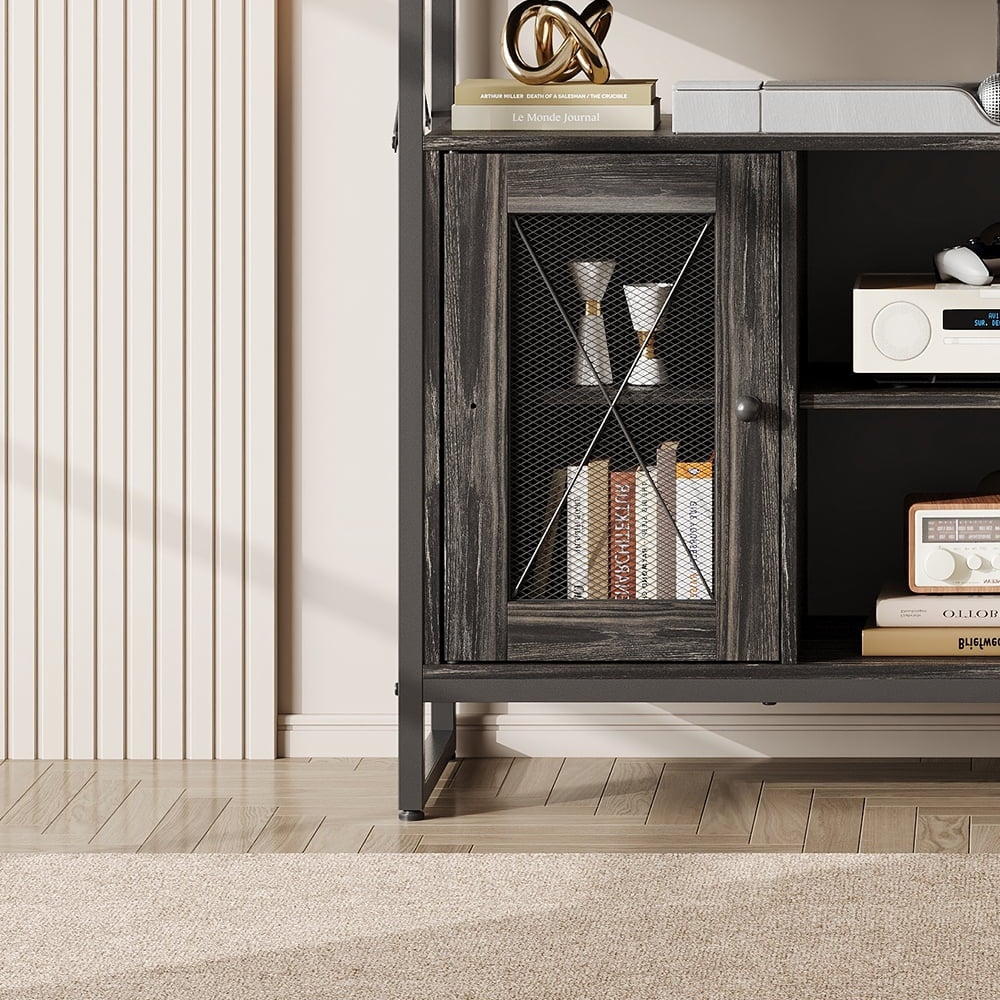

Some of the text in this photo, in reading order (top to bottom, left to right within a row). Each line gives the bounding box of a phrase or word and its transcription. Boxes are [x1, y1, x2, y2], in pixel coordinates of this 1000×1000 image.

[512, 112, 601, 124] Le Monde Journal
